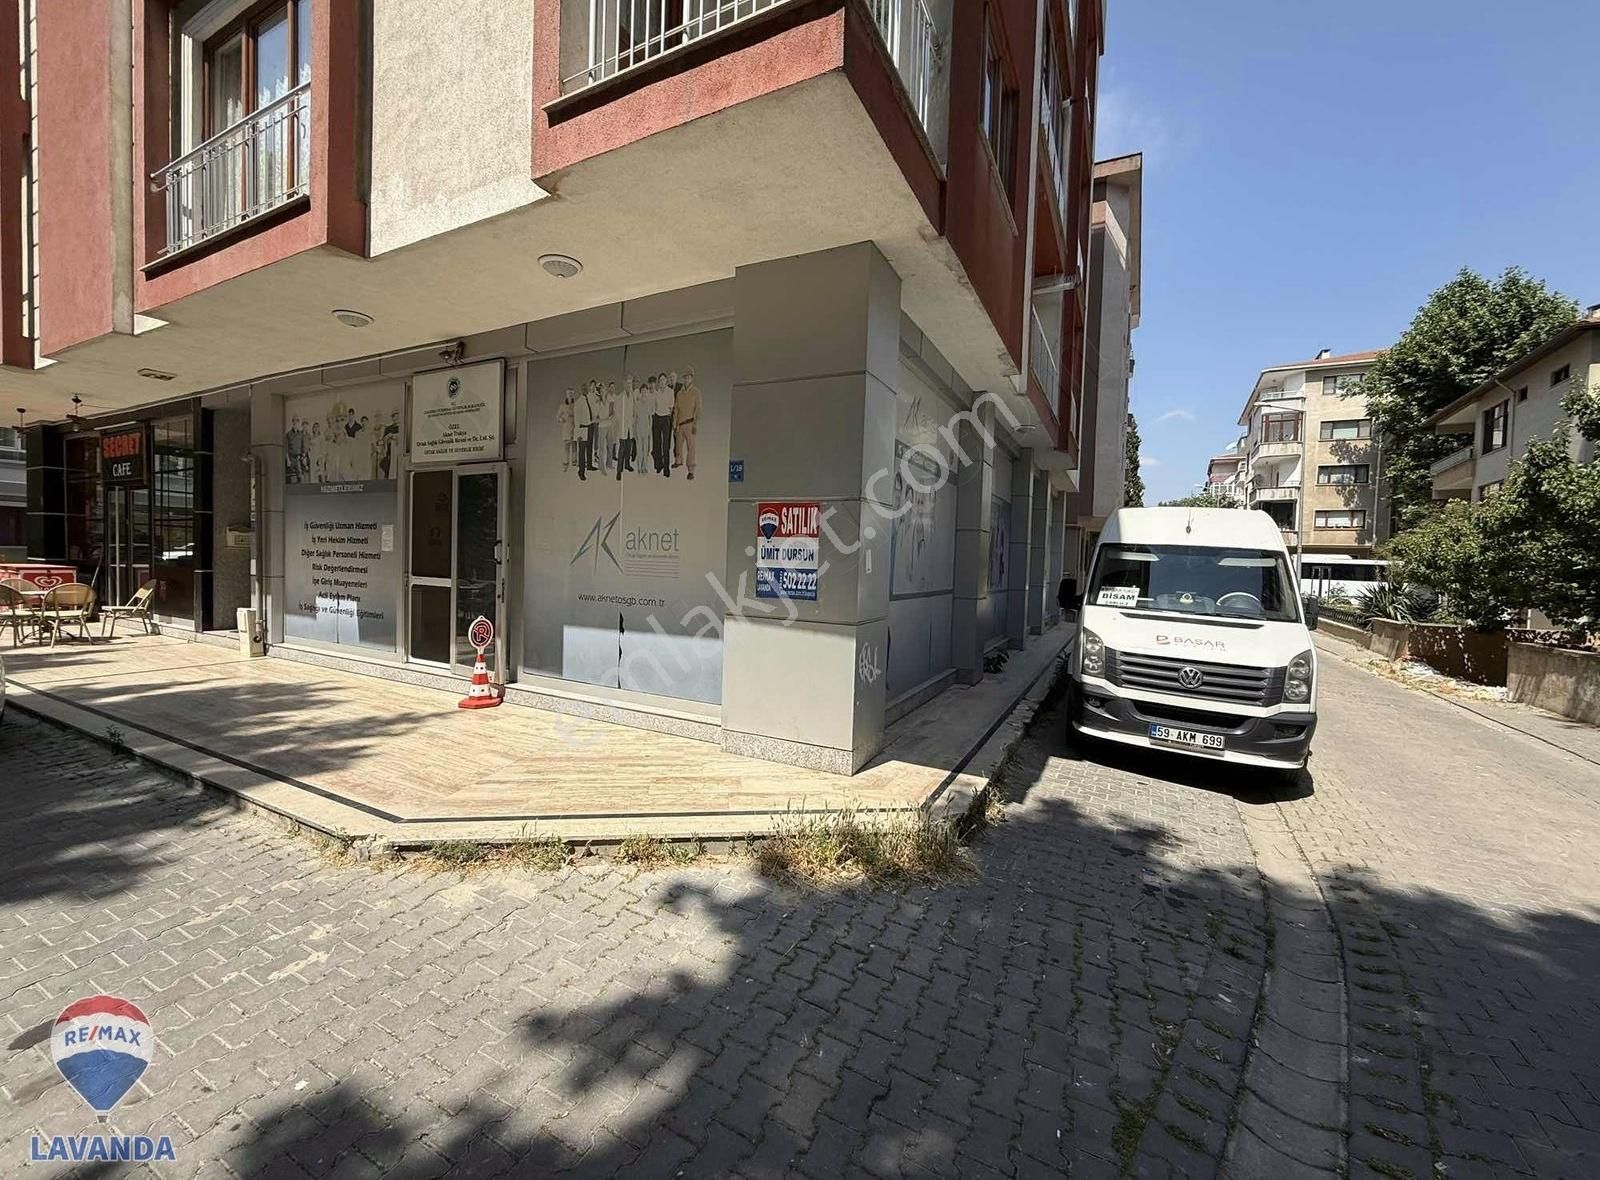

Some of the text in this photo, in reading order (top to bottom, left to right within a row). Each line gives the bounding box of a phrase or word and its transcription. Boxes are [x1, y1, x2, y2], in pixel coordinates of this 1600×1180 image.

[103, 432, 141, 459] SECRET
[112, 462, 132, 477] CAFE
[781, 506, 818, 535] SATILIK
[625, 526, 679, 552] aknet
[761, 545, 814, 561] ÜMİT DURSUN
[783, 571, 797, 589] 502
[797, 572, 807, 590] 22
[807, 572, 817, 590] 22
[1157, 727, 1222, 747] 59 AKM 699
